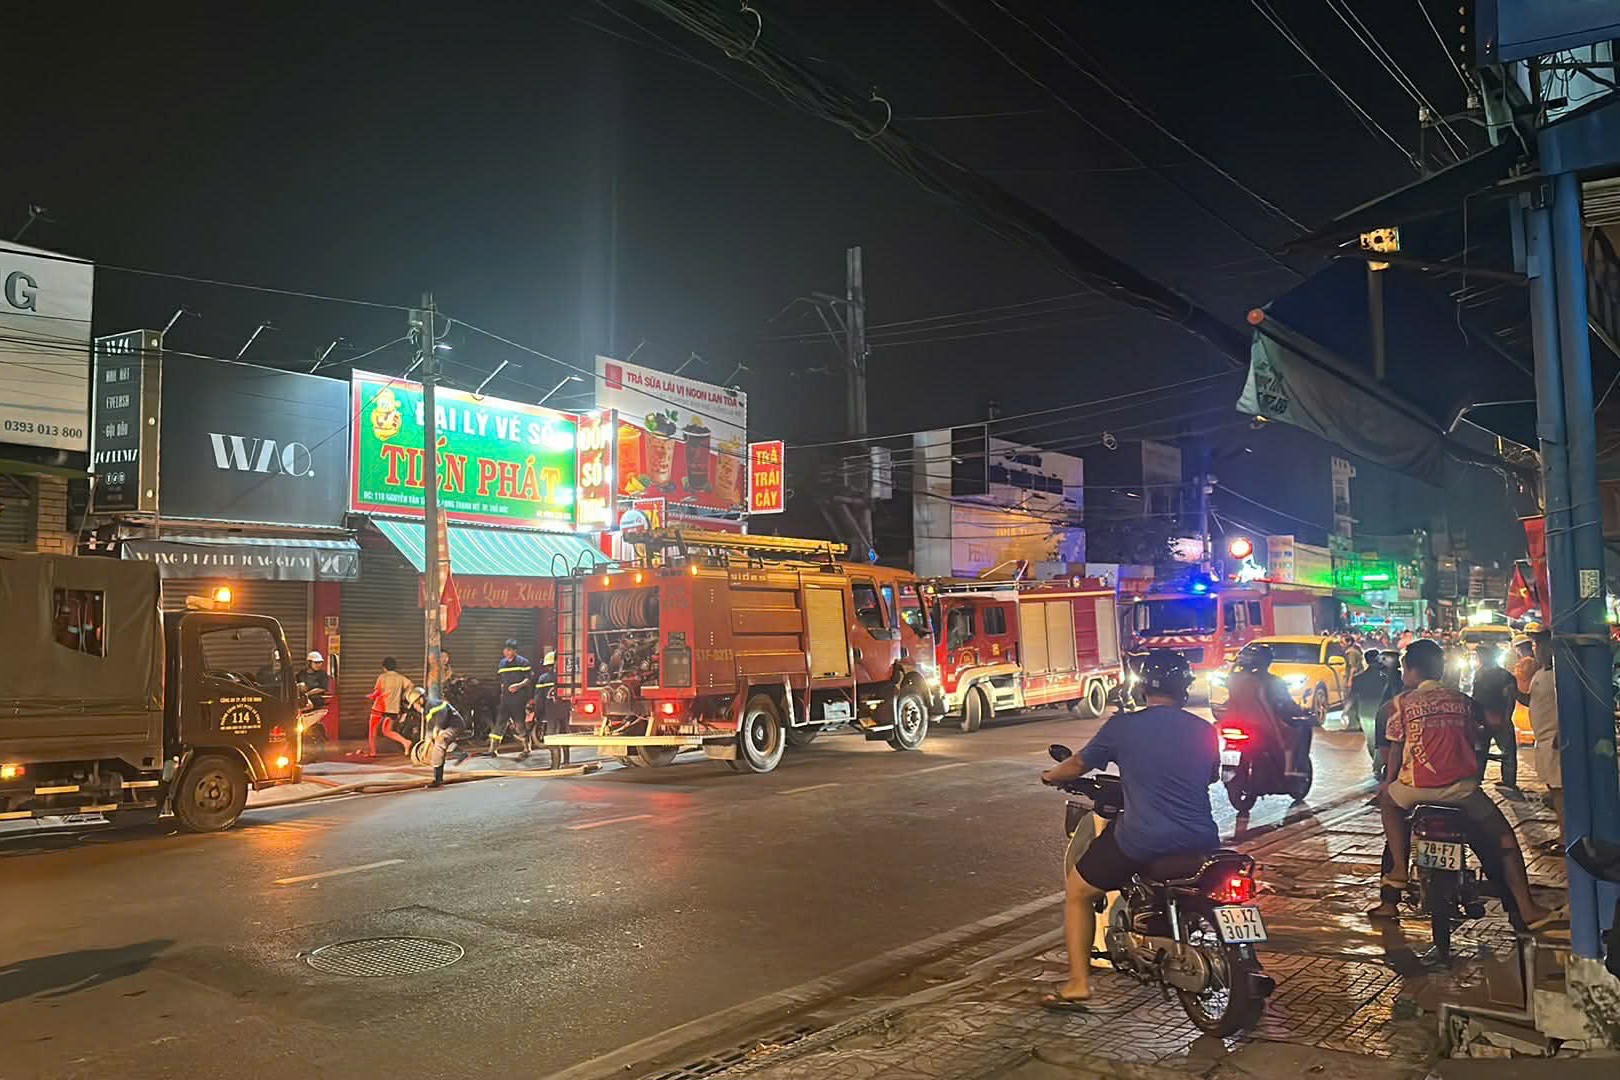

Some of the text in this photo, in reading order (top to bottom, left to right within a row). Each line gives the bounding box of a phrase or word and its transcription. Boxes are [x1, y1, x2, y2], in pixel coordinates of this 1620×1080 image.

[4, 419, 83, 439] 0393 013 800
[463, 409, 487, 437] LÝ
[494, 410, 521, 442] VÉ
[756, 446, 778, 465] TRÀ
[380, 434, 561, 505] TIẾN PHÁT
[755, 467, 780, 487] TRÁI
[755, 488, 777, 507] CÂY
[232, 711, 250, 723] 114
[1423, 842, 1456, 857] 78-F7
[1423, 854, 1456, 869] 3792
[1220, 908, 1257, 924] 51-X2
[1226, 924, 1261, 940] 3074
